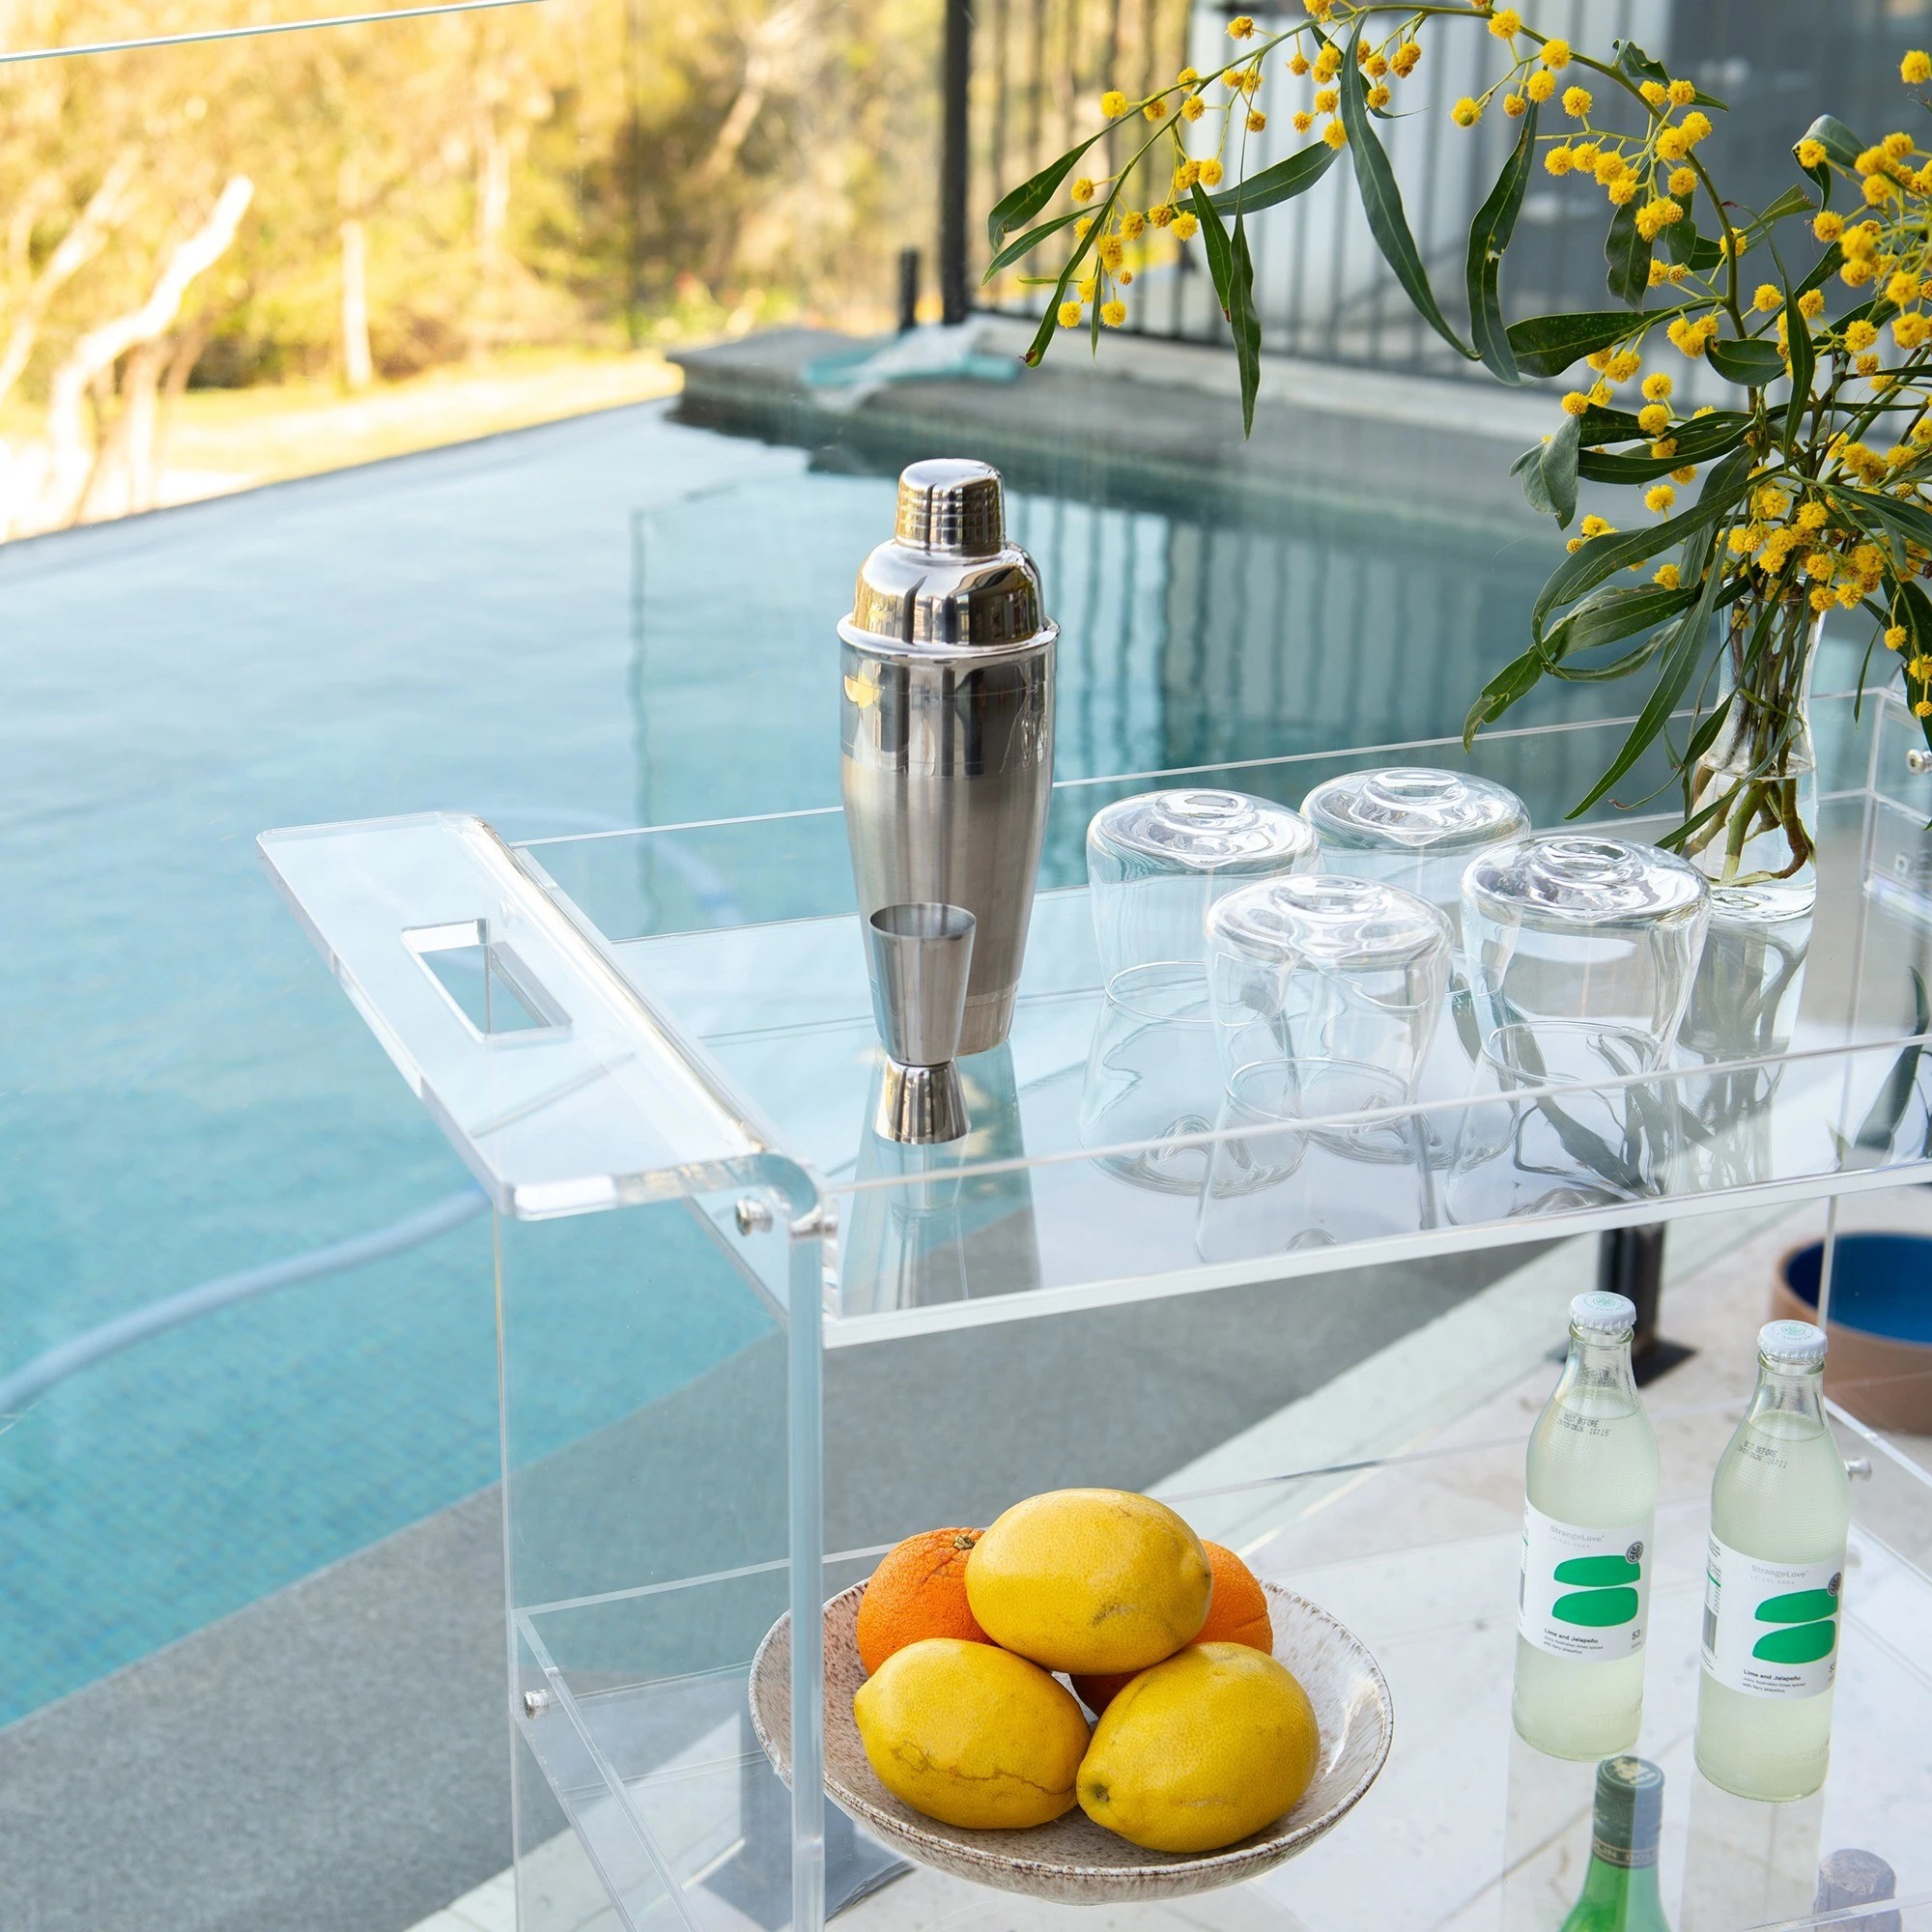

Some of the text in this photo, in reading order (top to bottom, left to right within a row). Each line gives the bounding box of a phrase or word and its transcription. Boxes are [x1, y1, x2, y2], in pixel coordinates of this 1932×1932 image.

[1577, 1417, 1600, 1428] BEFORE
[1755, 1446, 1778, 1458] BEFORE
[1544, 1628, 1557, 1636] Lime
